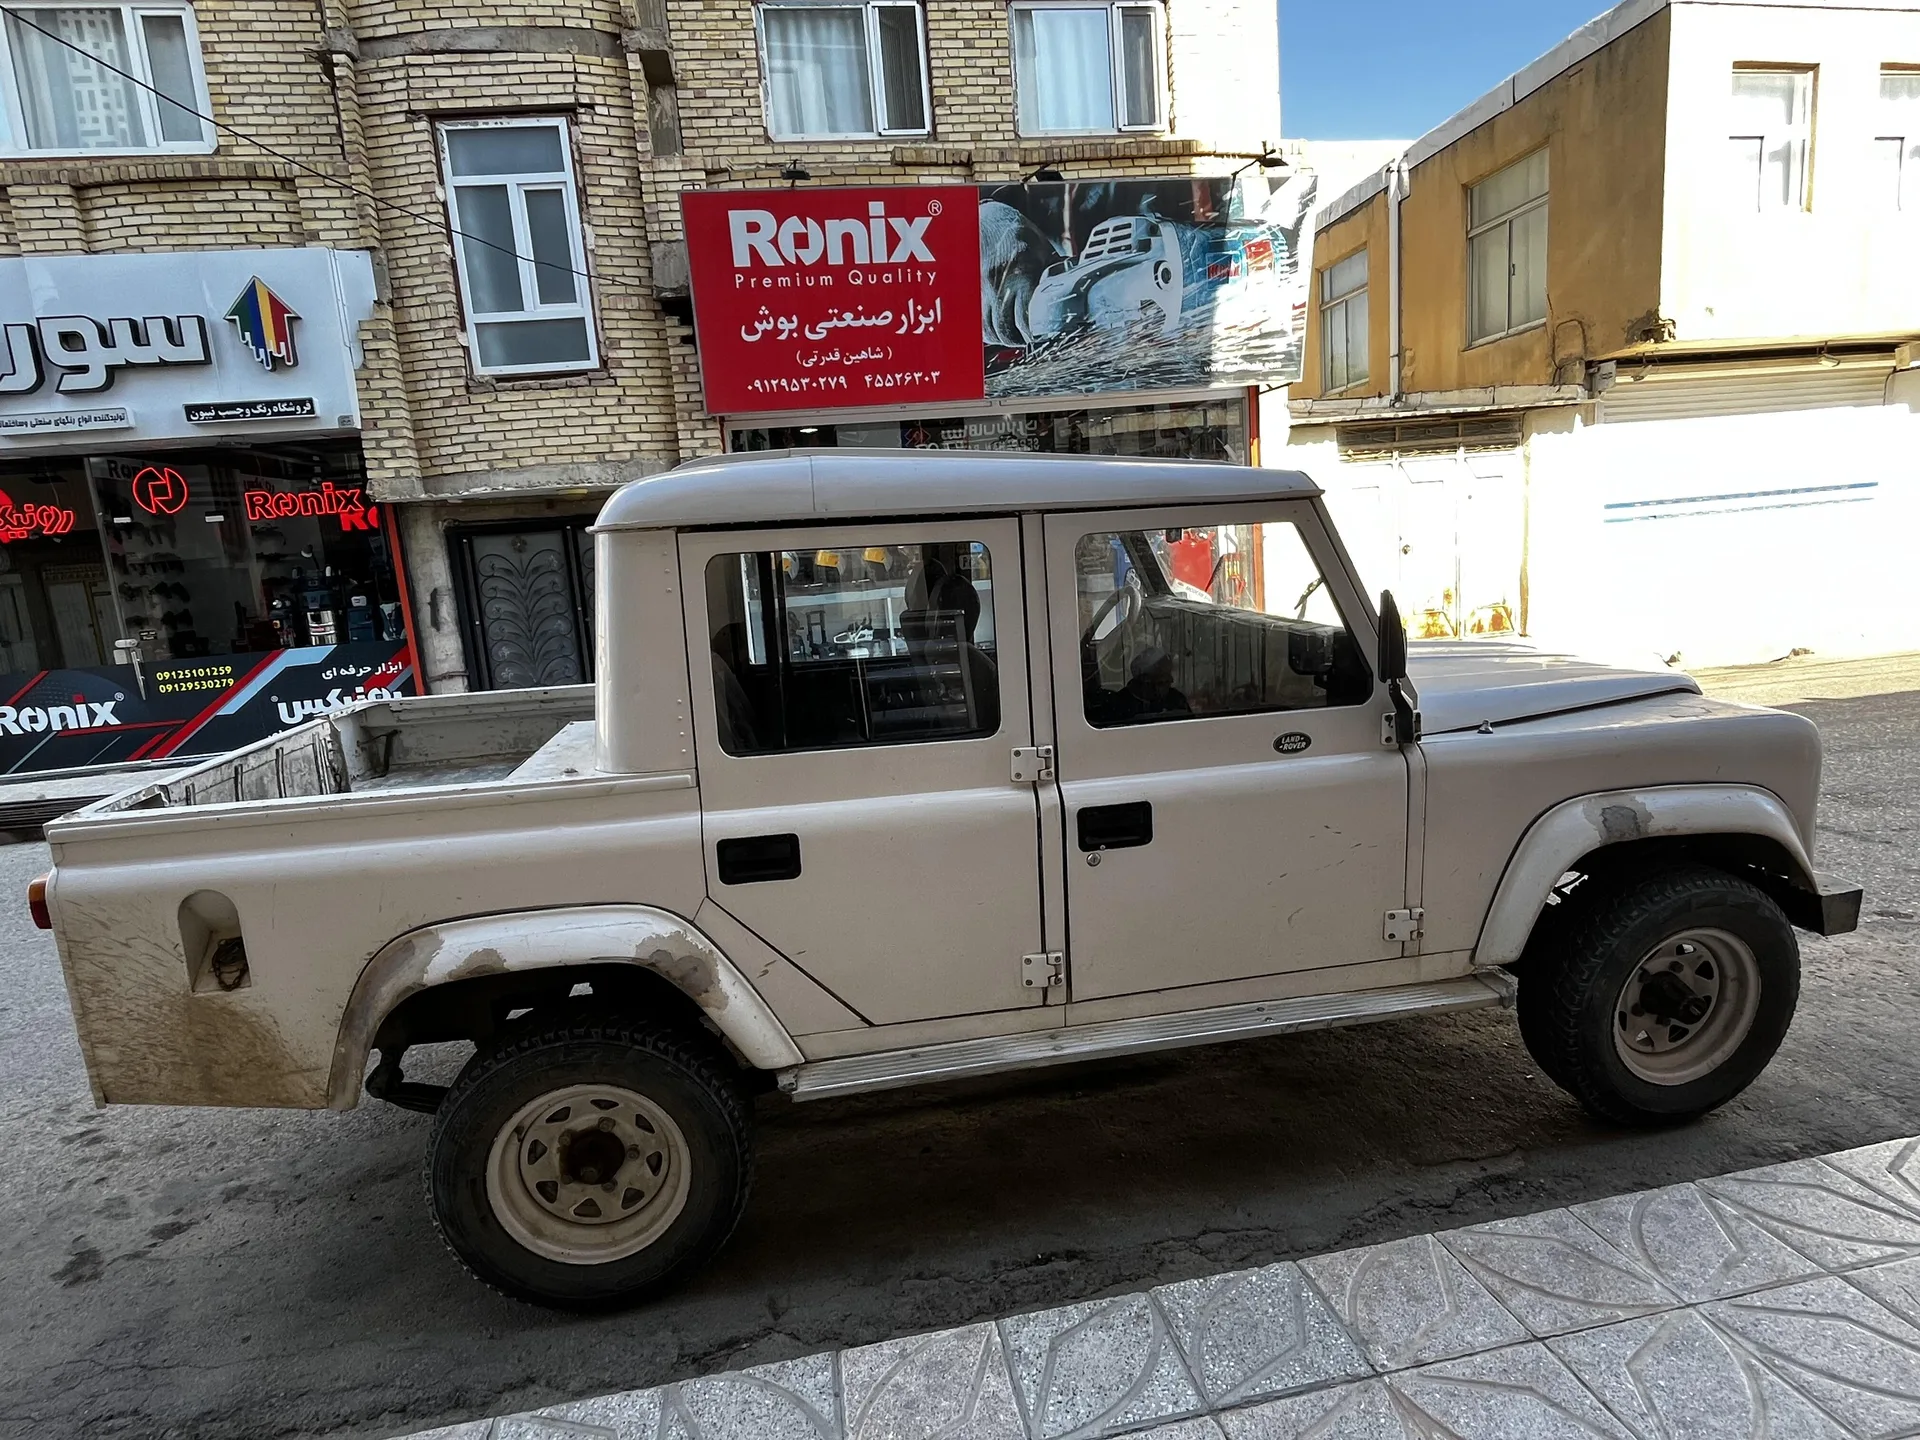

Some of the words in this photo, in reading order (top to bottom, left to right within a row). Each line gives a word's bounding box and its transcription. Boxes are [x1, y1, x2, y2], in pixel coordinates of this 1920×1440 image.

[728, 200, 936, 268] Ronix
[735, 273, 833, 289] Premium
[848, 269, 937, 287] Quality
[740, 305, 798, 342] بوش
[804, 303, 893, 341] صنعتی
[896, 297, 942, 335] ابزار
[746, 376, 847, 393] ۰۹۱۲۹۵۳۰۲۷۹
[864, 370, 941, 387] ۴۵۵۲۶۳۰۳
[273, 400, 312, 415] فروشگاه
[244, 482, 365, 520] Ronix
[156, 665, 232, 682] 09125101259
[340, 664, 372, 677] حرفه
[375, 661, 403, 676] ابزار
[158, 678, 234, 694] 09129530279
[0, 694, 121, 737] Ronix
[1281, 735, 1301, 744] LAND
[1283, 742, 1306, 751] ROVER
